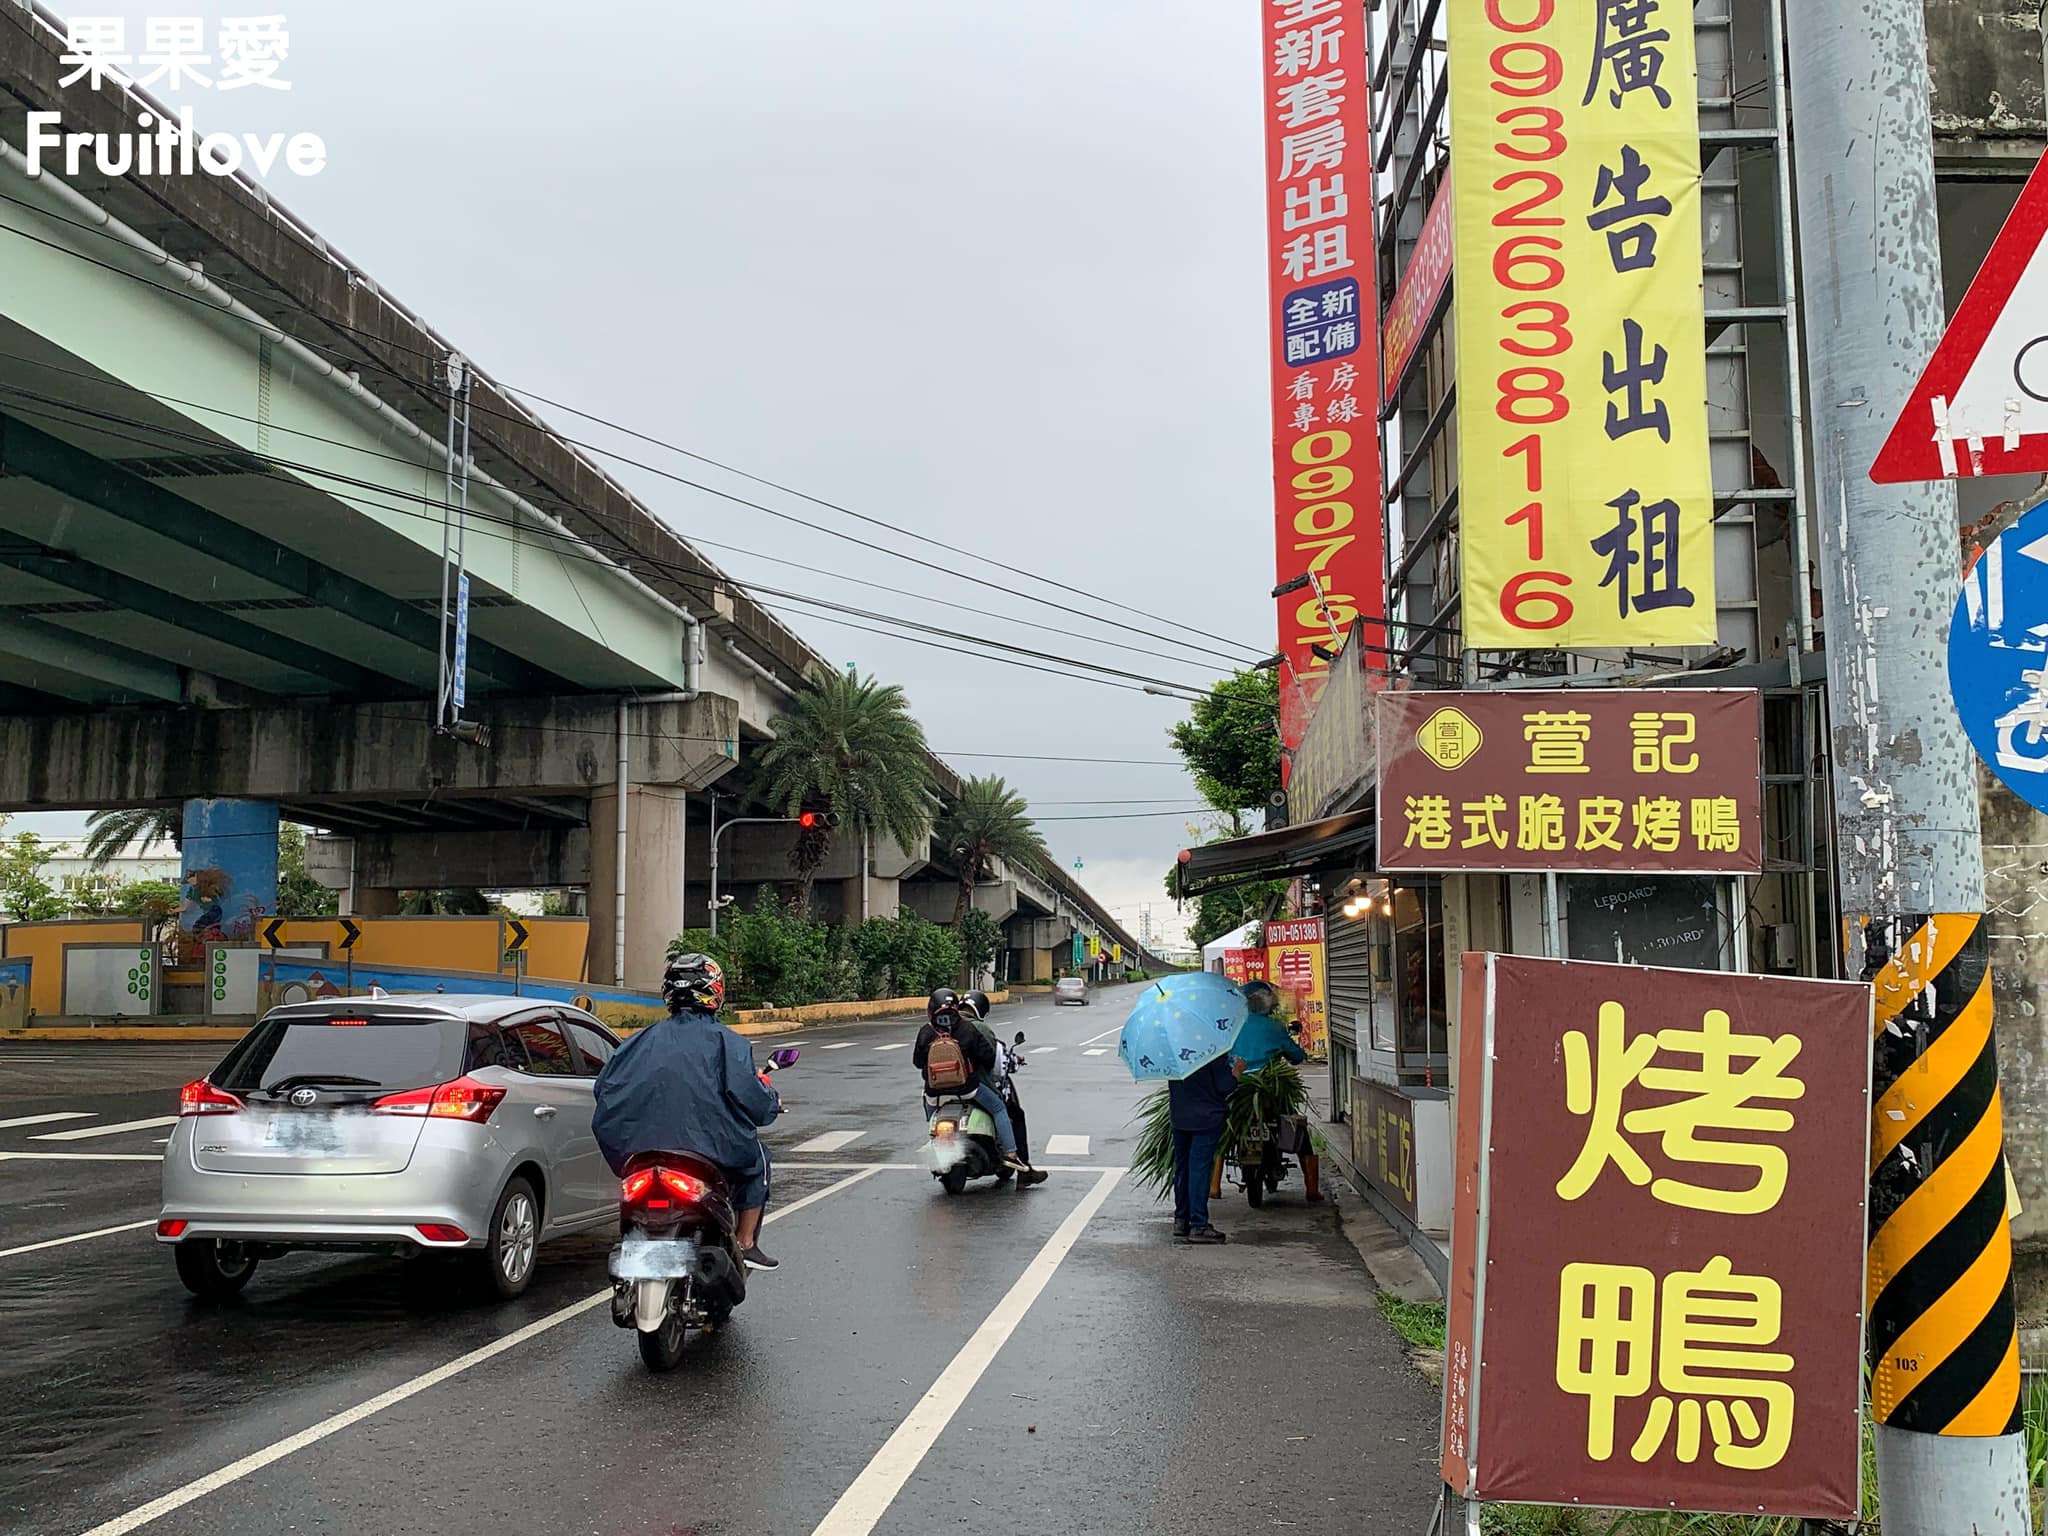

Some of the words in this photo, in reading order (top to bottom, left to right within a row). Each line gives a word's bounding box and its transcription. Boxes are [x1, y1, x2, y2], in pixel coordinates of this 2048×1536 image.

[1286, 286, 1356, 327] 全新
[1486, 0, 1574, 630] 0932638116
[1580, 0, 1694, 620] 廣告出租
[1287, 322, 1356, 362] 配備
[1522, 709, 1700, 774] 萱記
[1403, 793, 1741, 853] 港式脆皮烤鴨
[1268, 922, 1318, 943] 0970-051388
[1555, 1000, 1806, 1470] 烤鴨
[1895, 1357, 1918, 1371] 103
